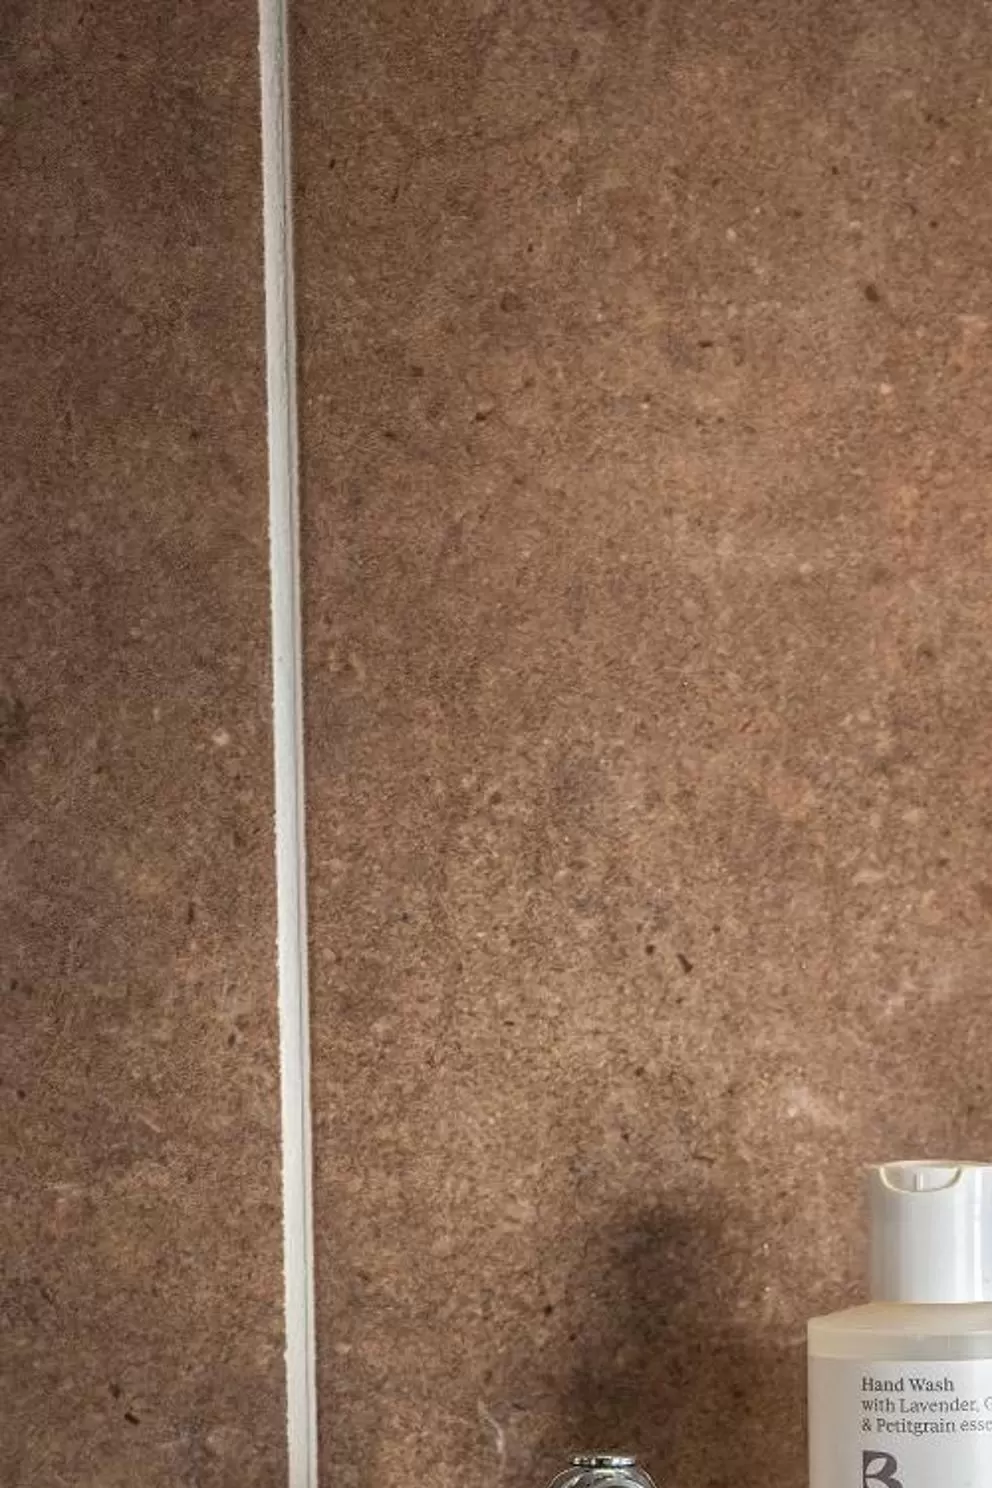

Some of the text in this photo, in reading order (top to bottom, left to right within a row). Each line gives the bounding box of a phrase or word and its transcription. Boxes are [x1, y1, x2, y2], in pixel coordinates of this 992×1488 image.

[861, 1377, 955, 1393] Hand Wash
[862, 1398, 896, 1413] with
[900, 1397, 981, 1414] Lavender,
[861, 1418, 873, 1433] &
[876, 1417, 956, 1437] Petitgrain
